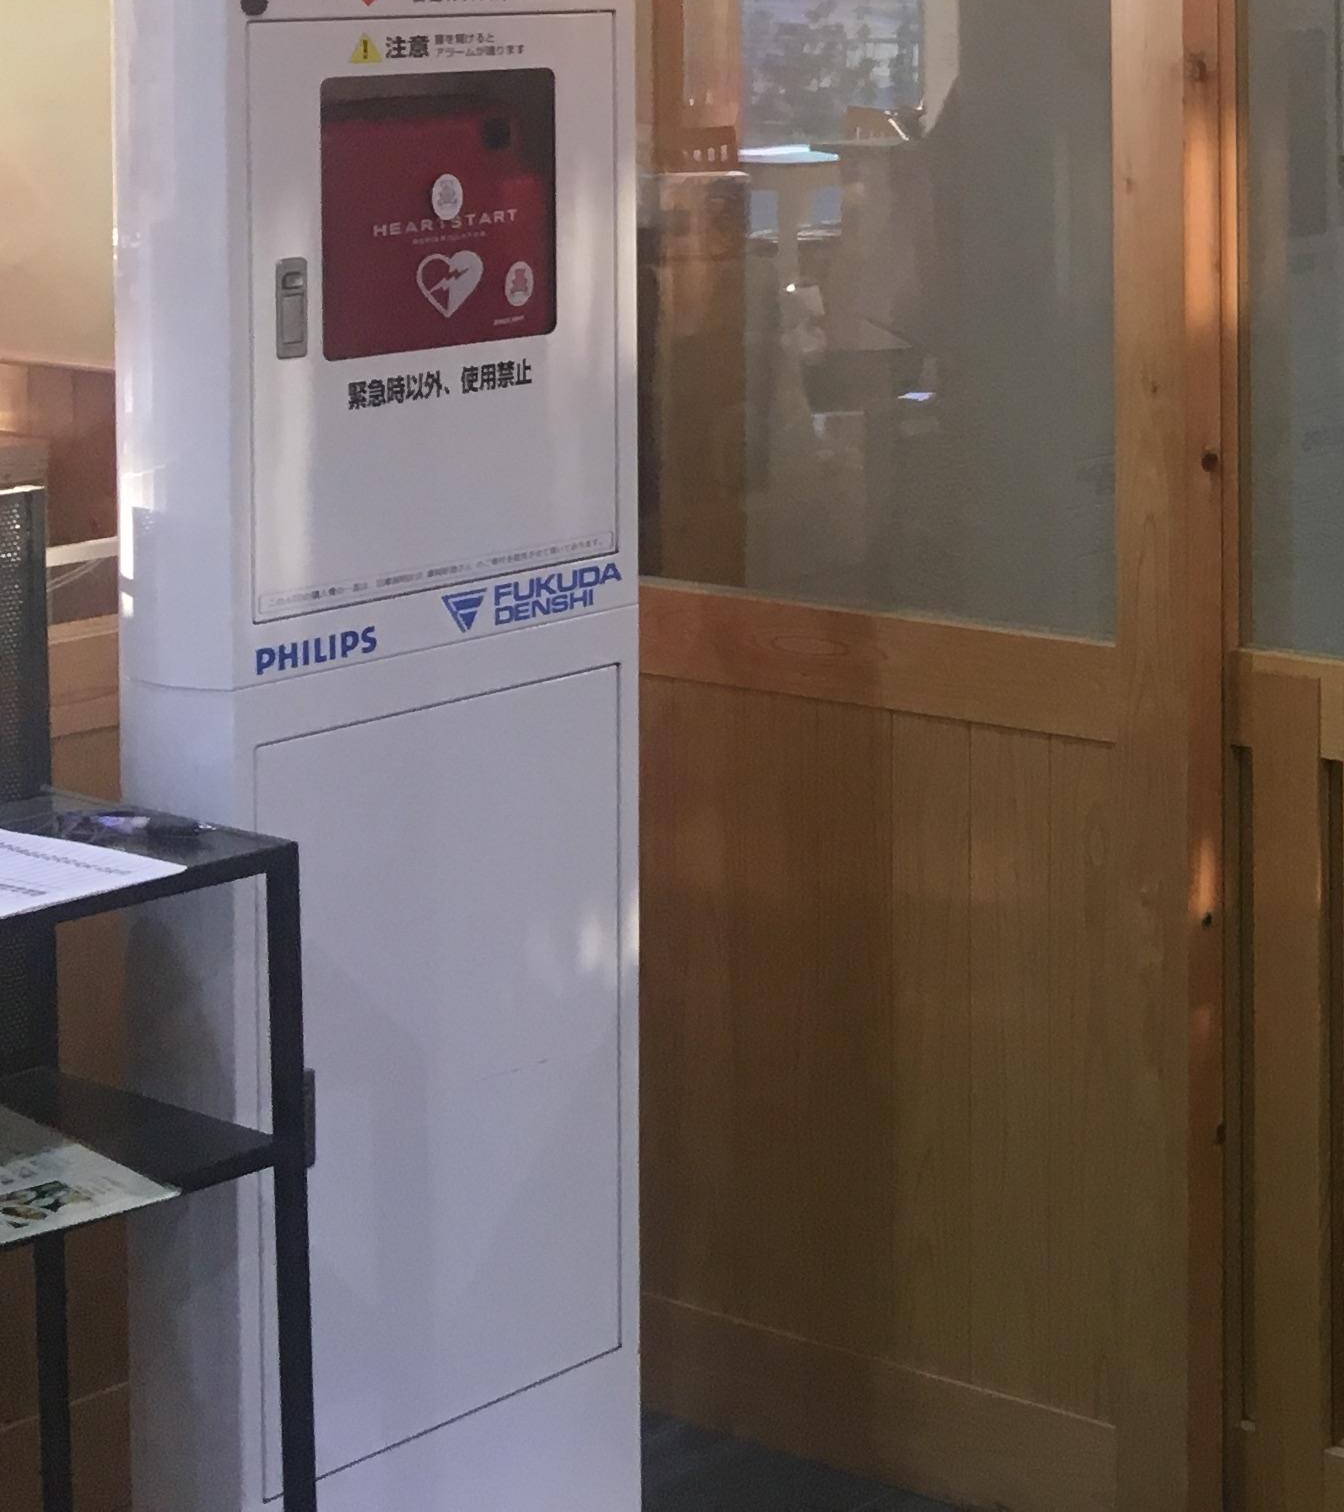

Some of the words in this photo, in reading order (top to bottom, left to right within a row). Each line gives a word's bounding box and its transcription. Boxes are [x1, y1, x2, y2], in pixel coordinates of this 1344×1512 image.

[385, 34, 430, 60] 注意
[348, 359, 533, 410] 緊急時以外、使用禁止
[494, 562, 622, 605] FUKUDA
[494, 589, 594, 626] DENSHI
[255, 625, 377, 676] PHILIPS
